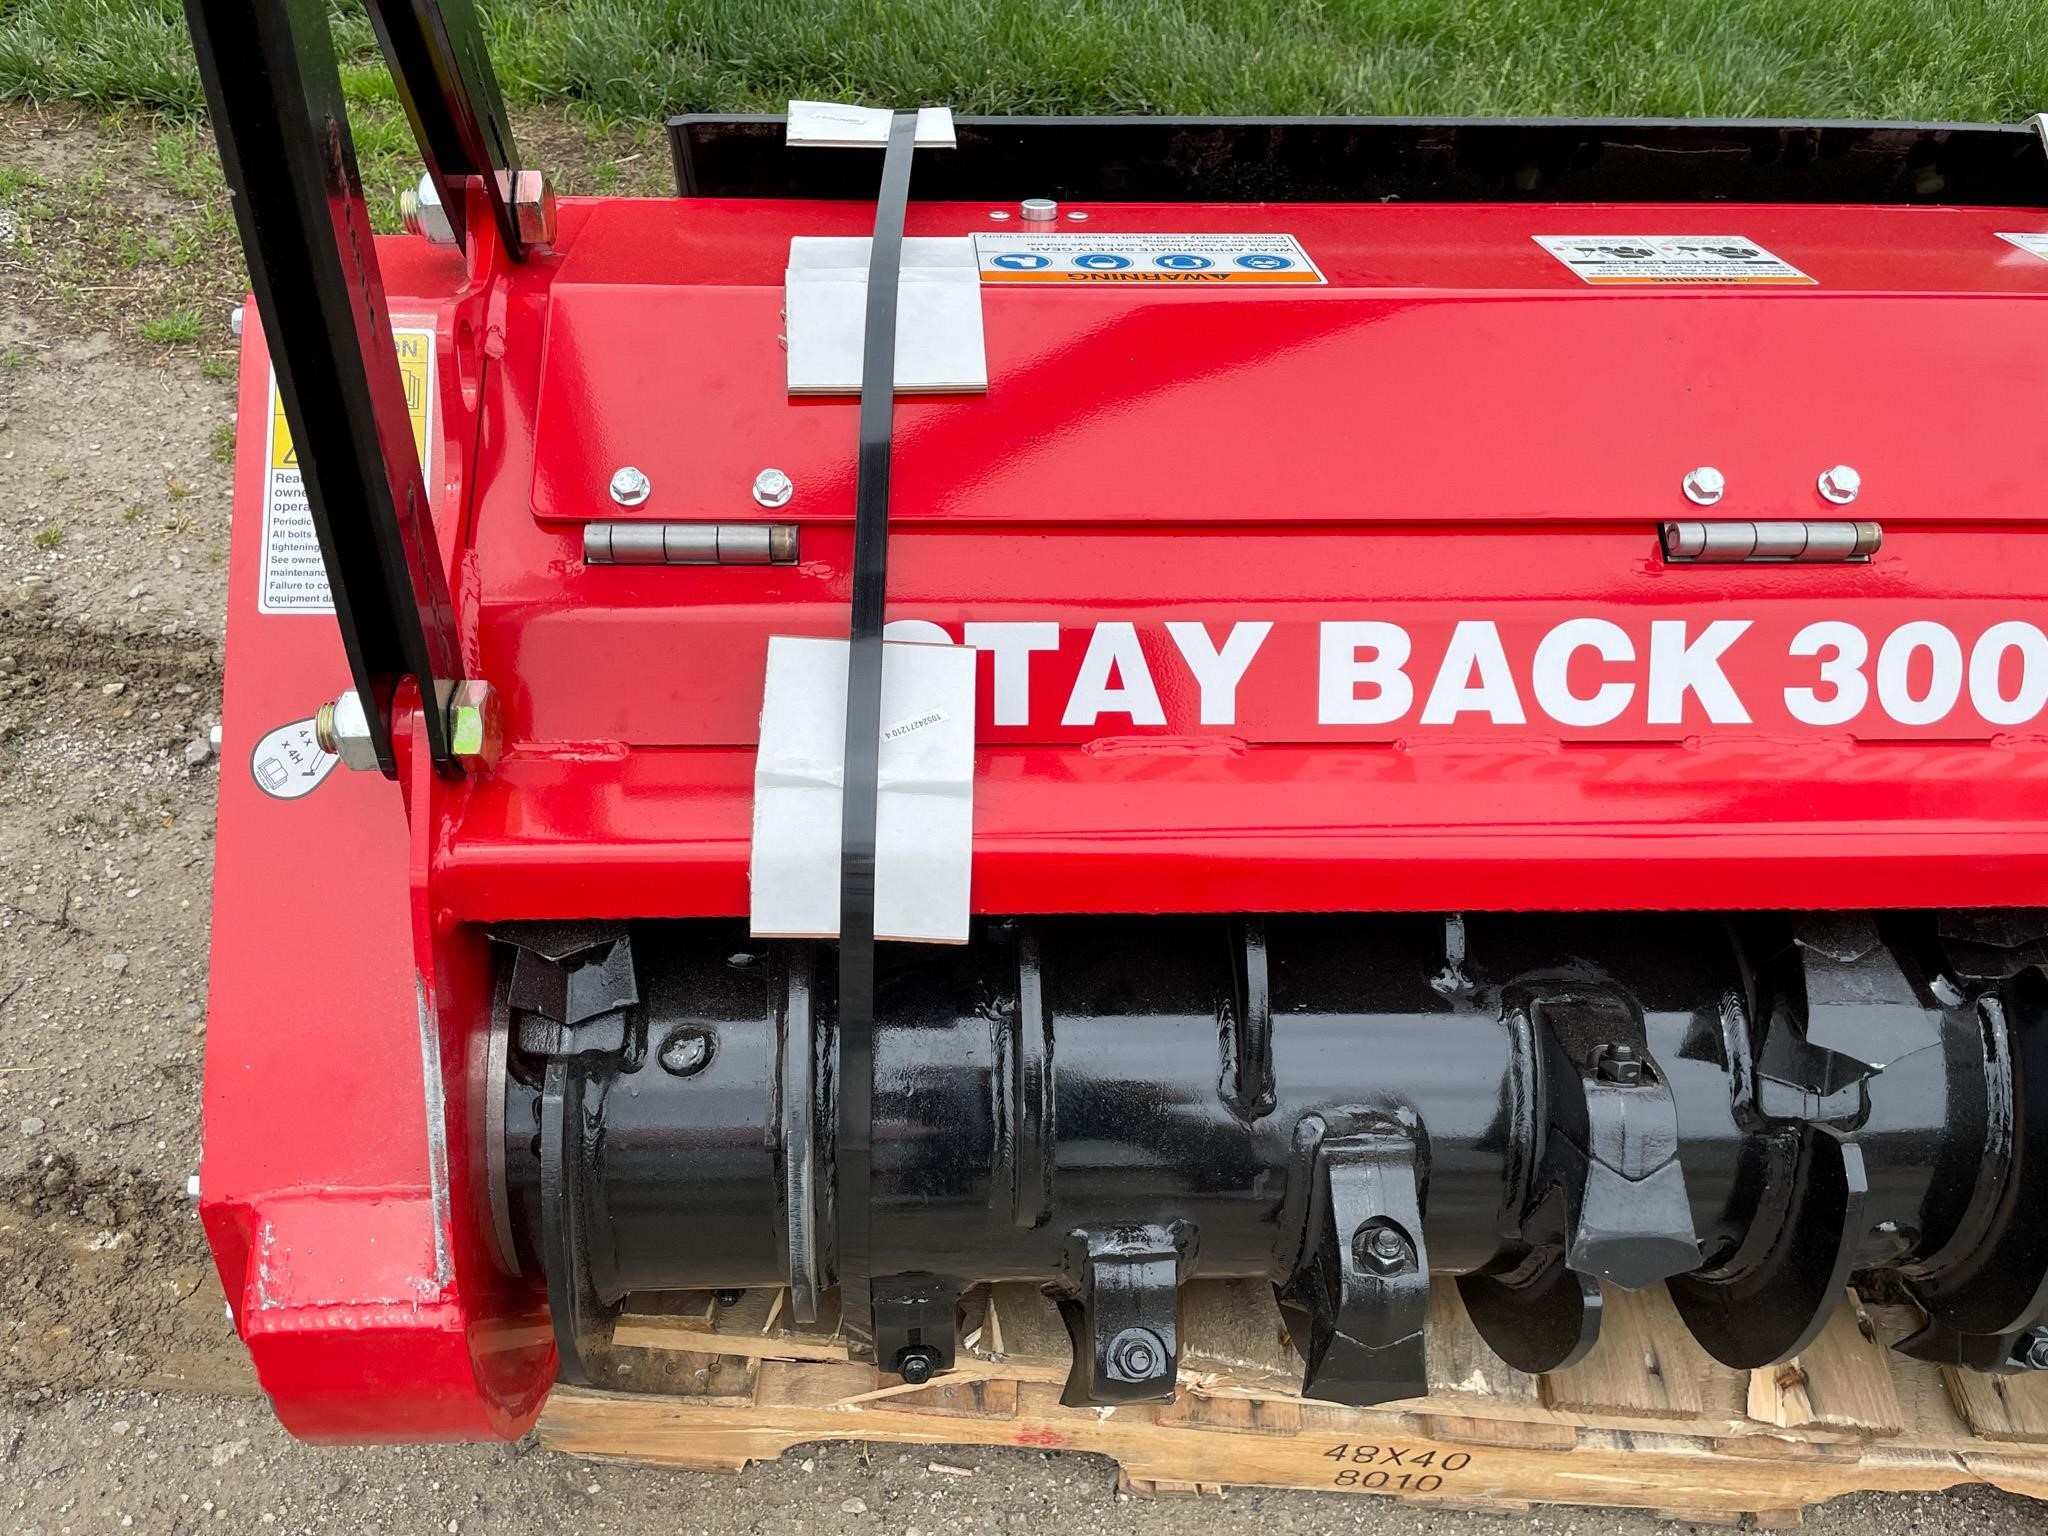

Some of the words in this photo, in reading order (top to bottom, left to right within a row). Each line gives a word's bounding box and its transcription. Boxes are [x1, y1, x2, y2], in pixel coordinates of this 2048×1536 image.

[1067, 273, 1210, 281] WARNING
[273, 517, 312, 526] Periodic
[272, 530, 285, 538] All
[287, 529, 312, 538] bolts
[271, 542, 320, 553] tightening
[271, 555, 289, 564] See
[270, 581, 303, 590] Failure
[305, 582, 315, 590] to
[269, 595, 320, 604] equipment
[883, 619, 1274, 726] TAY
[1318, 618, 1753, 726] BACK
[1783, 620, 2048, 726] 300
[891, 713, 942, 737] 10524271210
[1324, 1444, 1471, 1471] 48X40
[1334, 1470, 1443, 1492] 8010
